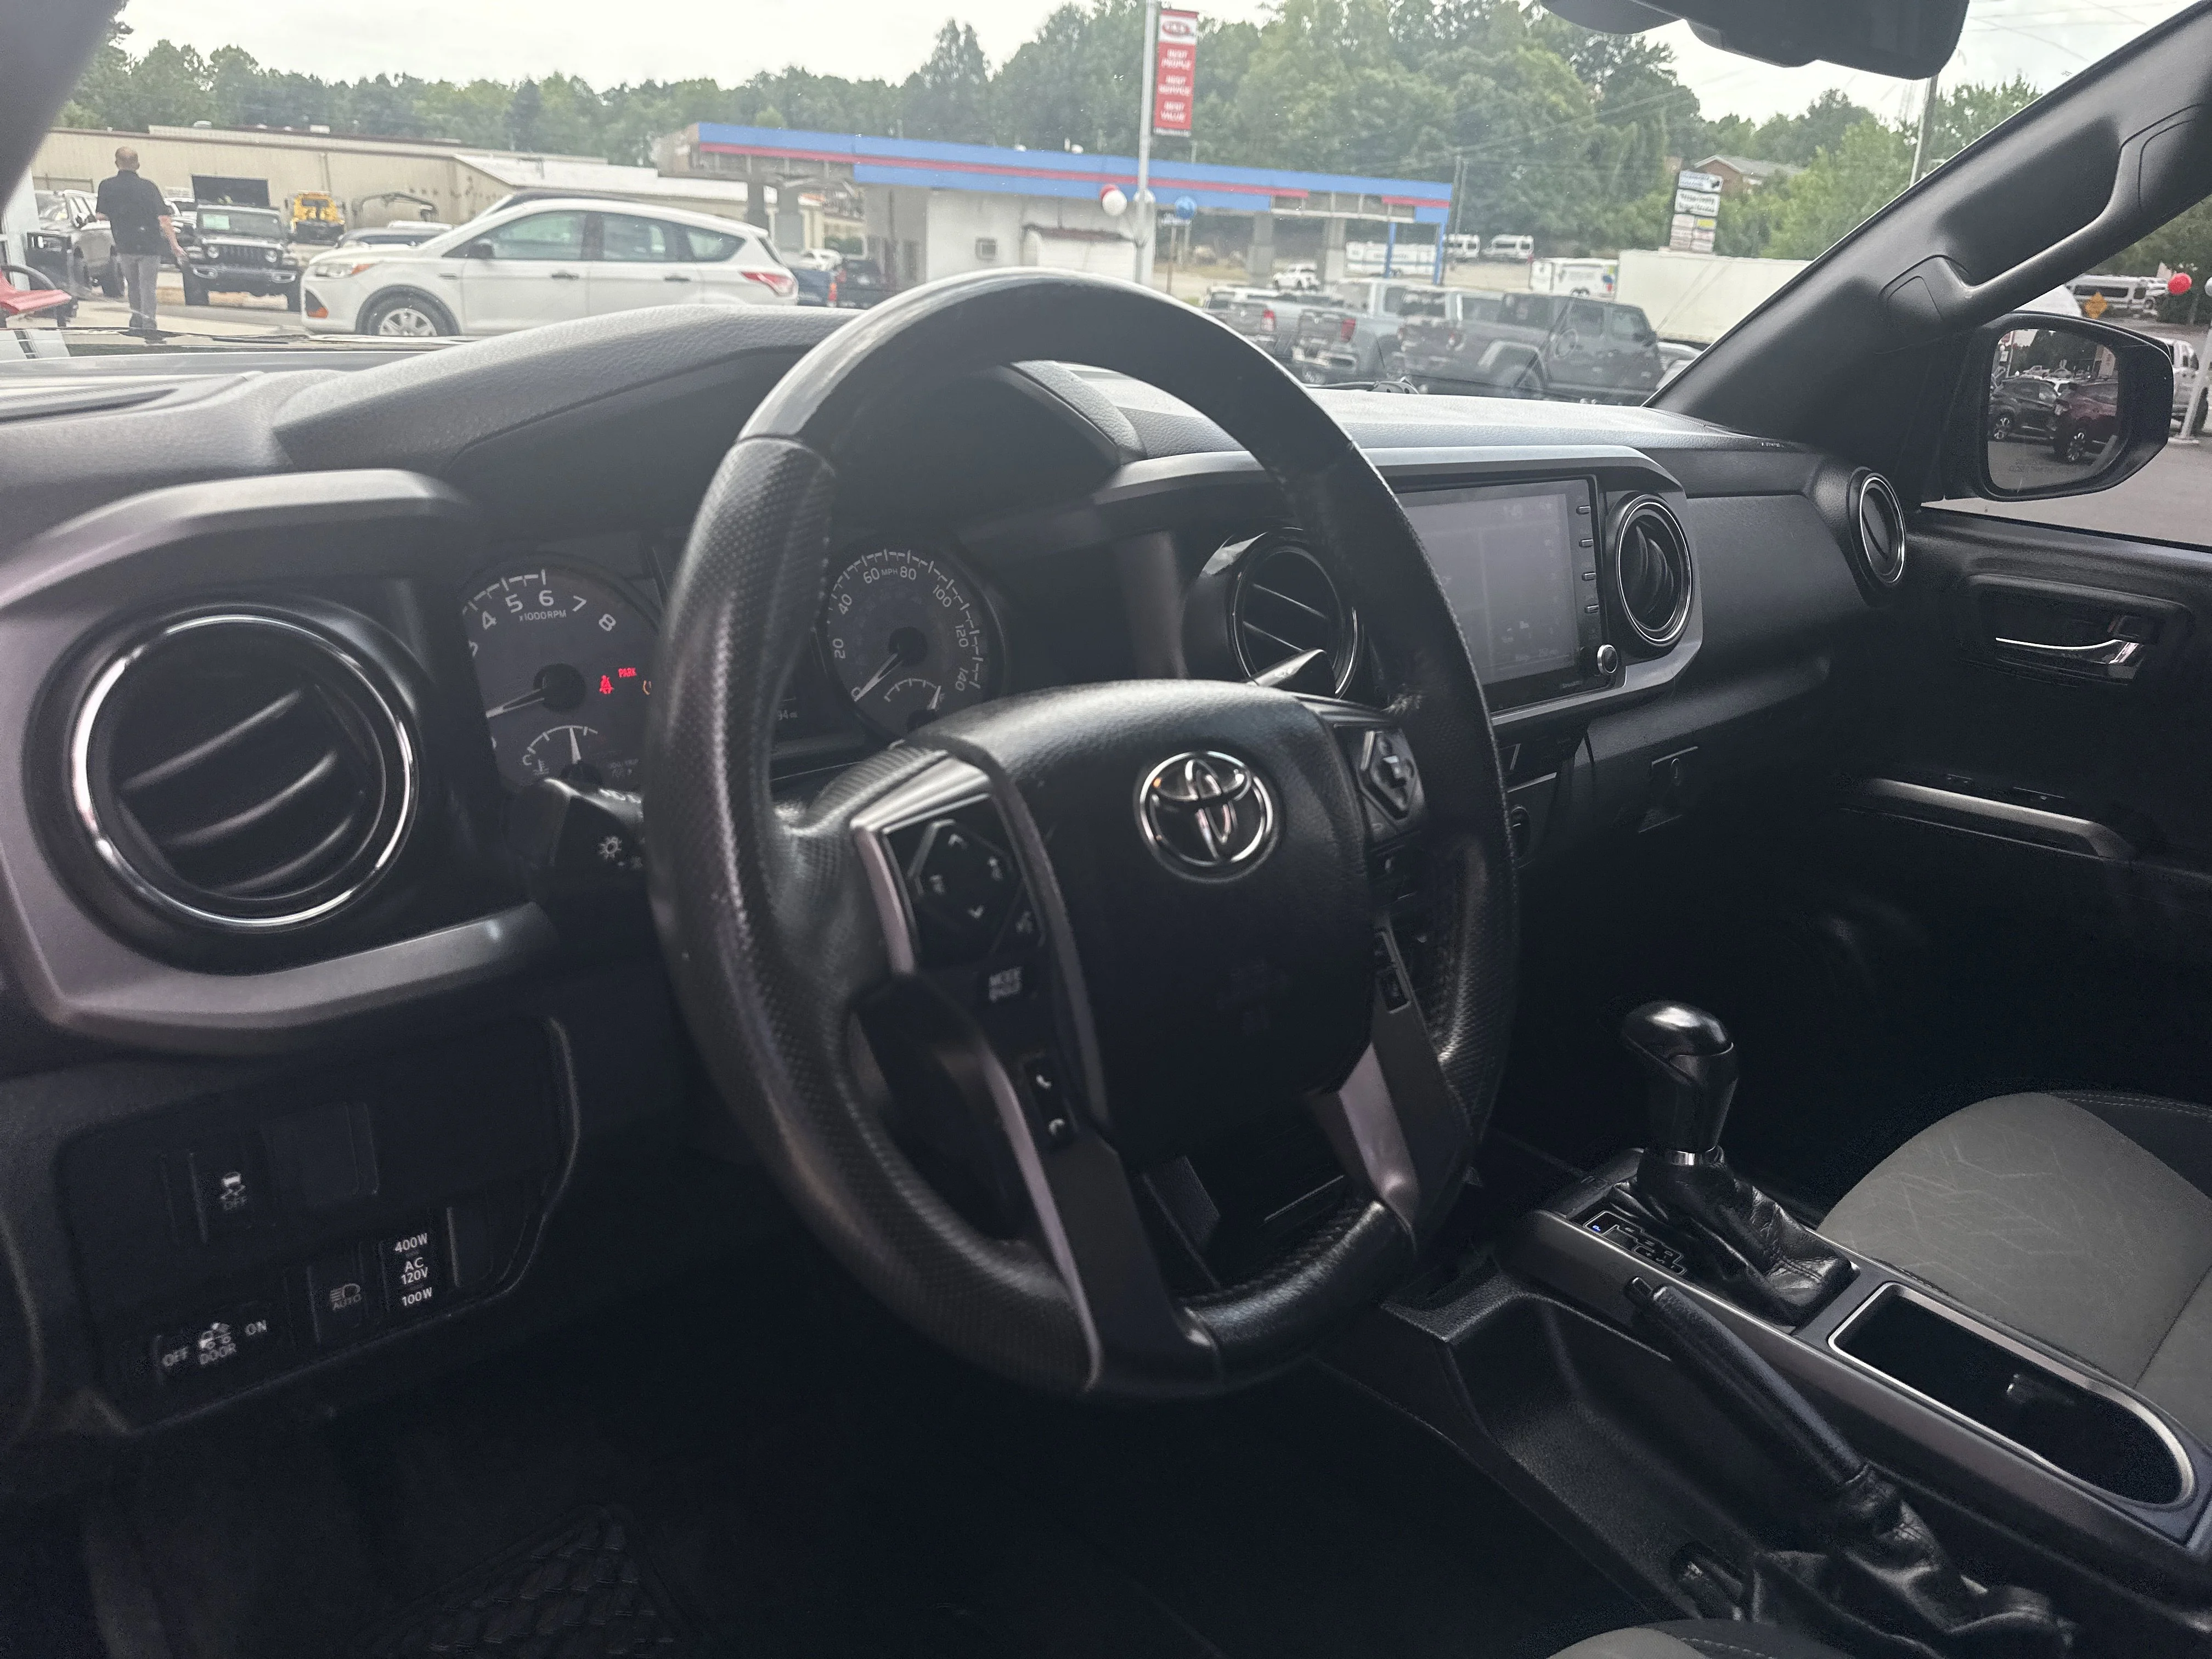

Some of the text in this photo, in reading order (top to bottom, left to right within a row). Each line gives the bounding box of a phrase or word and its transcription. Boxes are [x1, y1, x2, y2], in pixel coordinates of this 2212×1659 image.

[863, 567, 880, 583] 60
[881, 568, 898, 576] MPH
[900, 566, 917, 580] 80
[505, 594, 523, 613] 5
[539, 590, 554, 606] 6
[572, 595, 587, 612] 7
[838, 594, 852, 615] 40
[933, 584, 952, 607] 100
[481, 611, 497, 630] 4
[599, 613, 617, 631] 8
[955, 624, 968, 647] 120
[832, 639, 845, 659] 20
[618, 667, 637, 678] PARK
[955, 667, 969, 691] 140
[522, 754, 532, 766] C
[394, 1232, 428, 1252] 400W
[404, 1256, 424, 1273] AC
[400, 1266, 428, 1285] 120V
[332, 1293, 362, 1311] AUTO
[402, 1286, 433, 1307] 100W
[245, 1319, 268, 1336] ON
[162, 1346, 188, 1367] OFF
